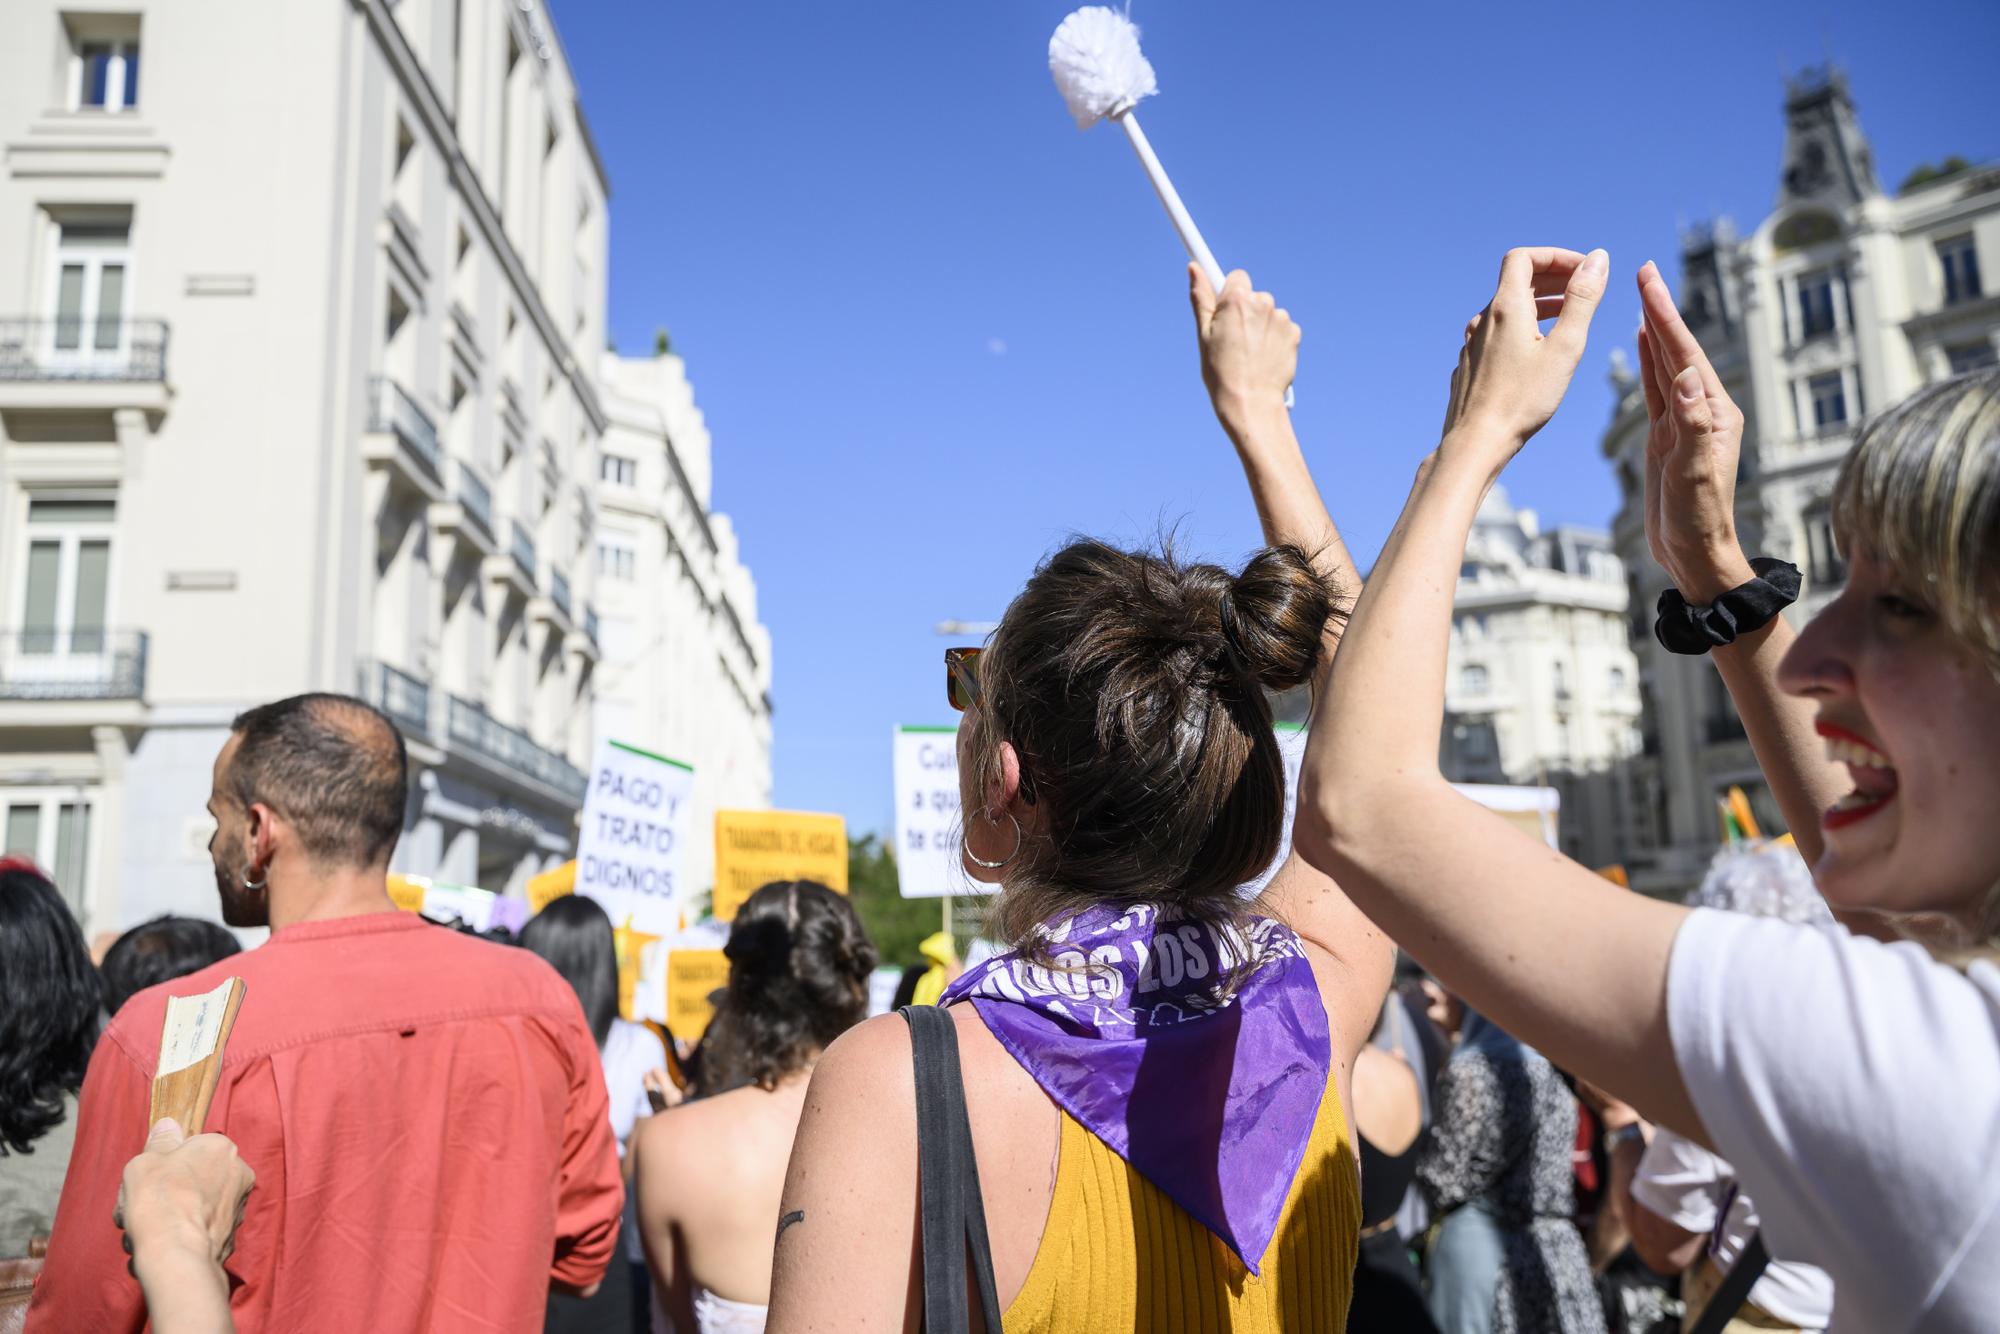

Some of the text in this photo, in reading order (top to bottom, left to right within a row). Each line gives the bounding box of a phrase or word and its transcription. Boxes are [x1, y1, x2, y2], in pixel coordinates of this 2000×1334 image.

[597, 768, 664, 810] PAGO
[598, 812, 675, 854] TRATO
[584, 854, 674, 898] DIGNOS
[1131, 924, 1210, 994] LOS
